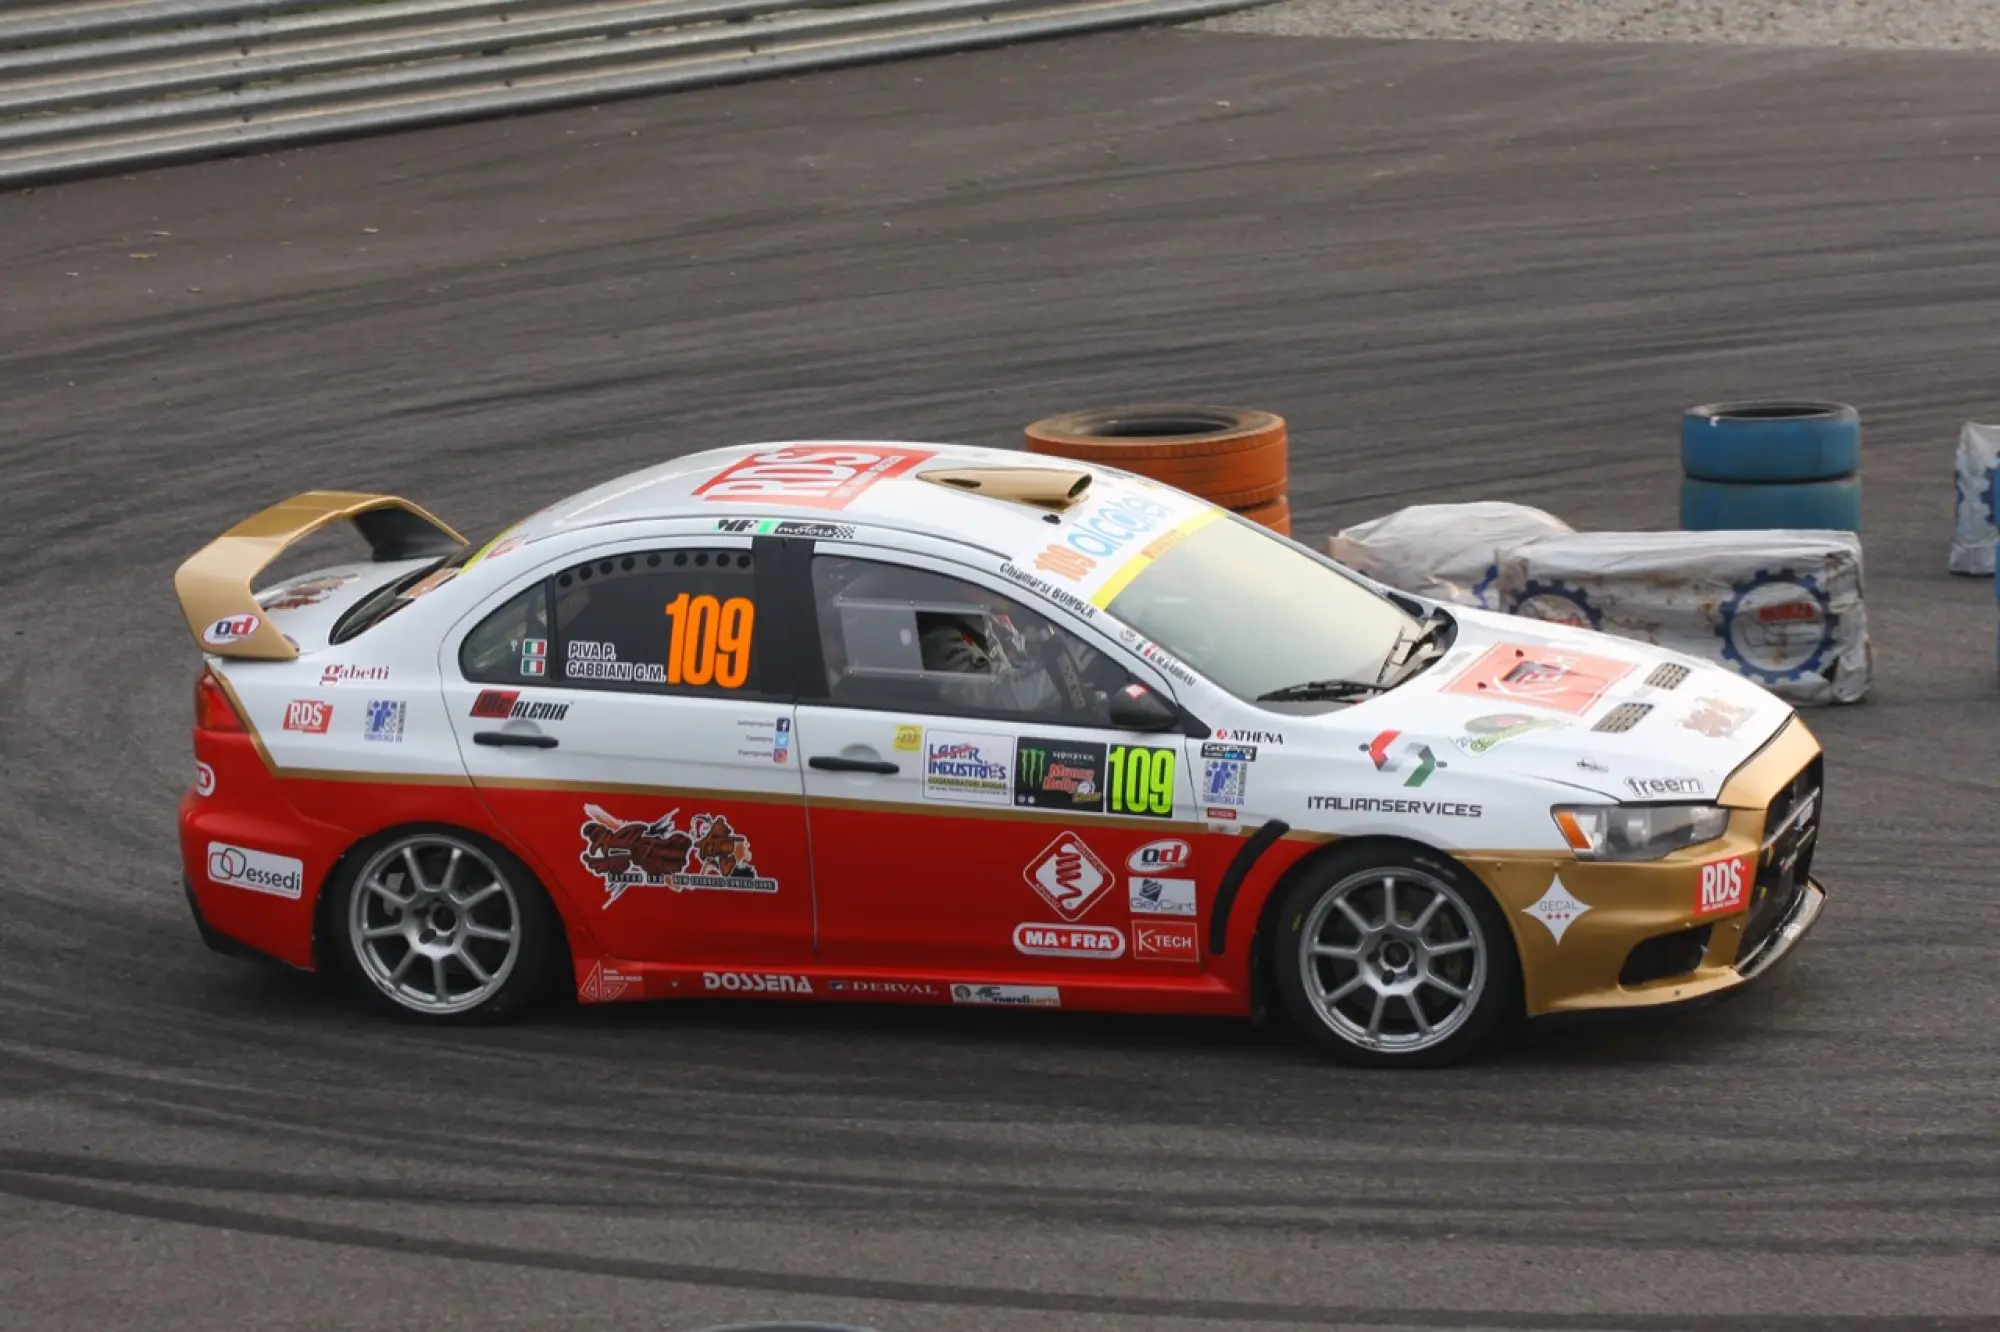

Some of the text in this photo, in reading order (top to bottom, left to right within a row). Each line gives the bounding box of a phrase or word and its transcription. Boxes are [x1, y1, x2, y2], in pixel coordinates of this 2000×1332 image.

[569, 641, 617, 661] PIVA P.
[665, 592, 756, 689] 109
[319, 664, 390, 685] gabetti
[566, 660, 667, 682] GABBIANI G.M.
[288, 702, 324, 727] RDS
[1229, 730, 1284, 745] ATHENA
[1108, 745, 1176, 814] 109
[1307, 795, 1483, 818] ITALIANSERVICES
[1702, 858, 1741, 905] RDS
[1539, 898, 1579, 911] GECAL
[703, 971, 813, 994] DOSSENA
[852, 980, 939, 995] DERVAL
